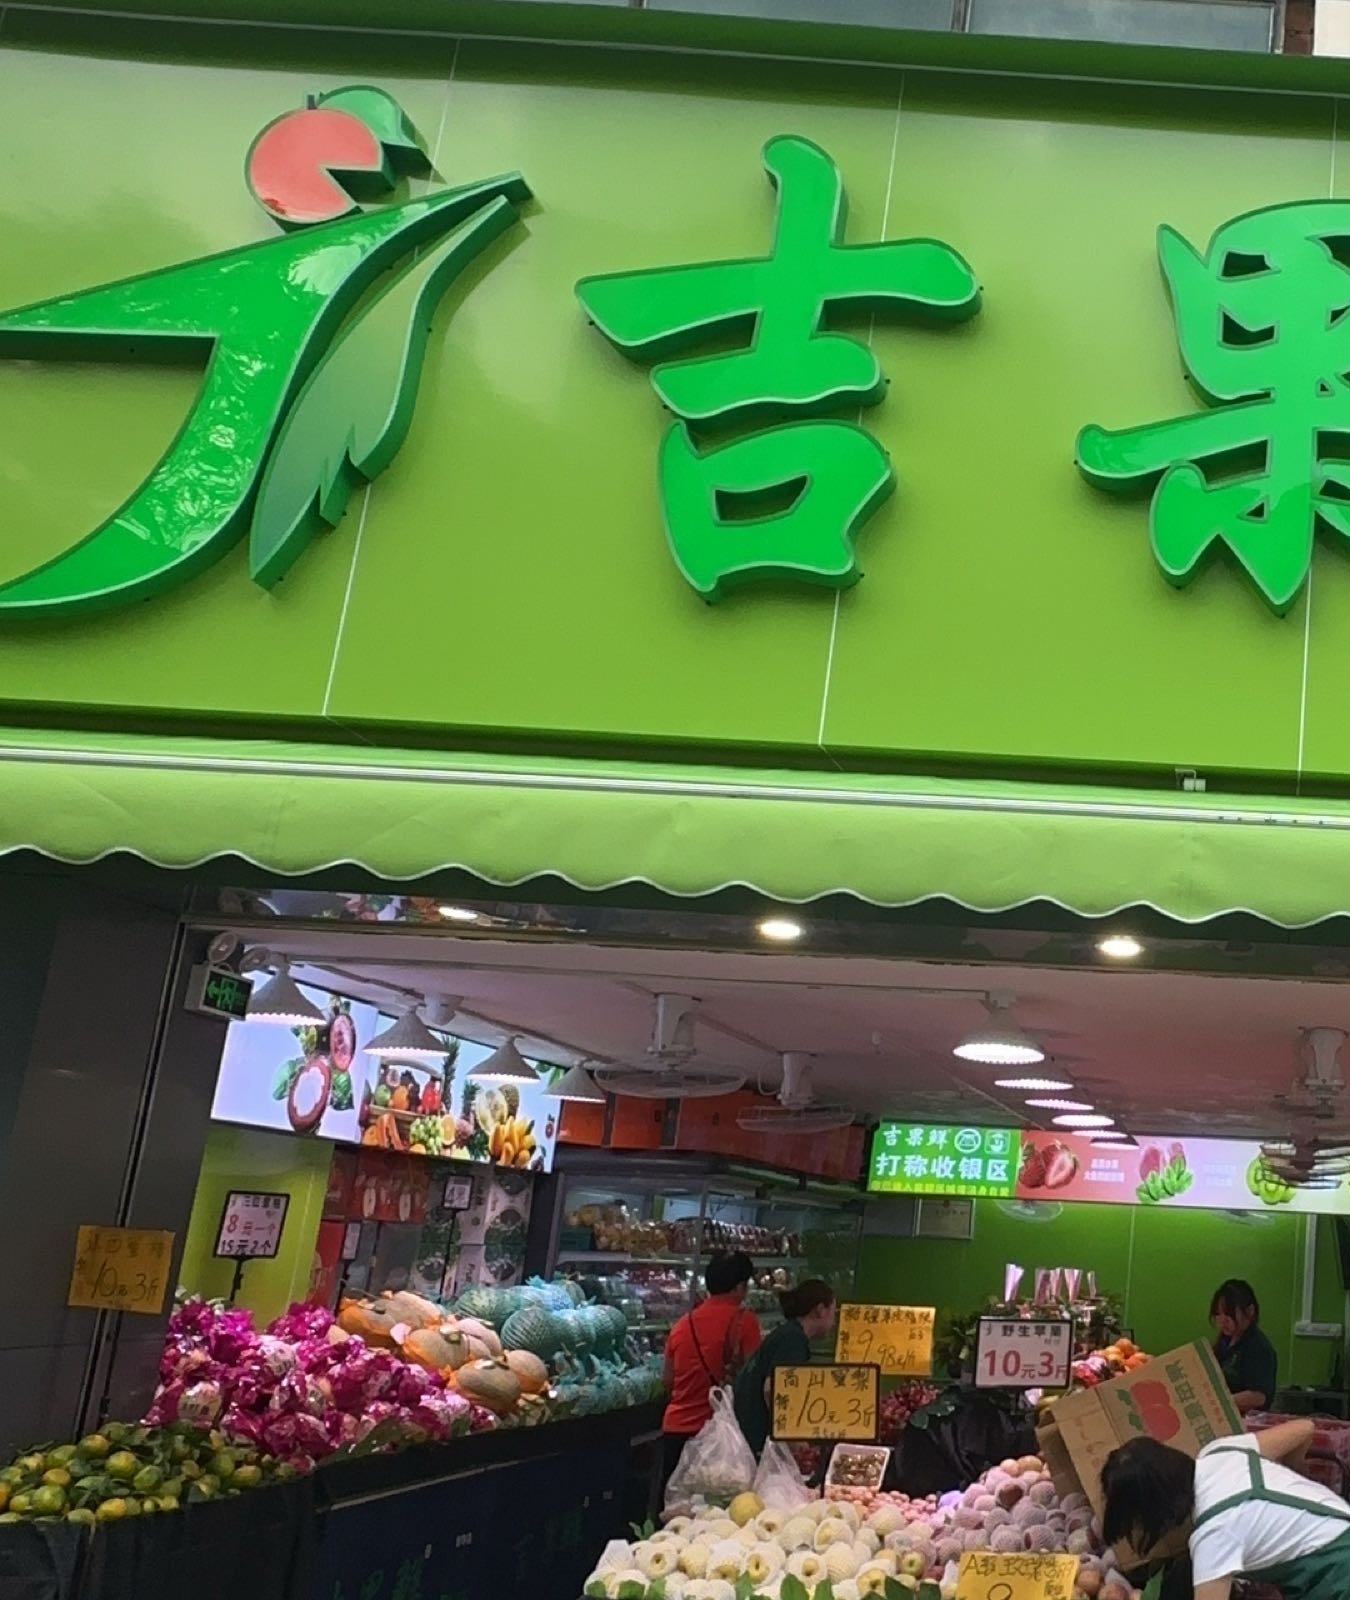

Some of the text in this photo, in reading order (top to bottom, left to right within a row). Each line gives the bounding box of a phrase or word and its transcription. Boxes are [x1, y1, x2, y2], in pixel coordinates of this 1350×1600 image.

[883, 1123, 949, 1150] 吉果鲜
[875, 1152, 1009, 1182] 打称收银区
[983, 1349, 1068, 1380] 10元3斤
